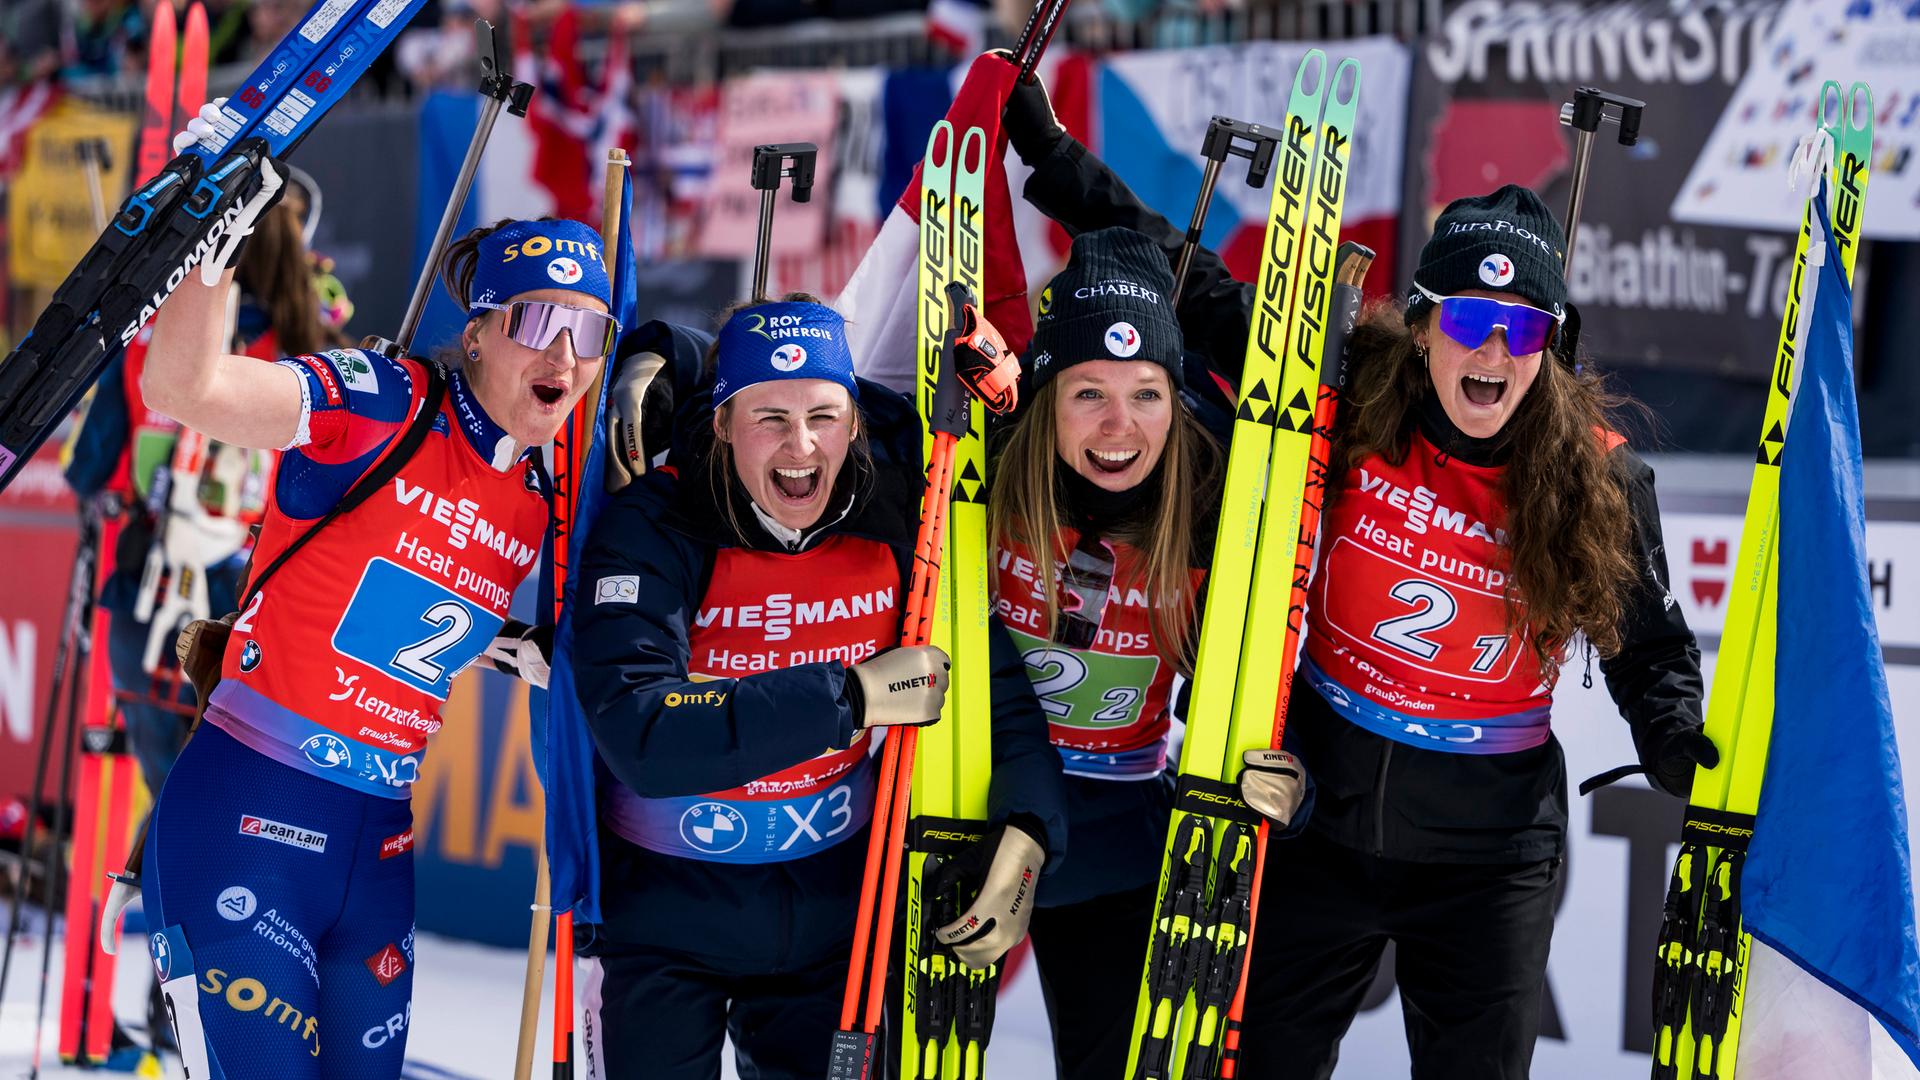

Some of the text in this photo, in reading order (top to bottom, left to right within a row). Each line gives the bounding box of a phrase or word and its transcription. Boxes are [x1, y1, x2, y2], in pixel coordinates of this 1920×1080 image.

[1257, 115, 1313, 362] FISCHER
[1297, 124, 1348, 372] FISCHER
[122, 198, 246, 347] SALOMON
[1074, 284, 1160, 304] CHABERT
[769, 315, 803, 328] ROY
[770, 327, 833, 341] ENERGIE
[394, 476, 536, 568] VIESSMANN
[1354, 514, 1414, 559] Heat
[395, 531, 511, 610] Heat pumps
[234, 590, 264, 632] 2
[694, 586, 894, 642] VIESSMANN
[998, 598, 1042, 629] eat
[1370, 578, 1511, 674] 2 1
[389, 600, 474, 686] 2
[708, 647, 779, 672] Heat
[664, 689, 727, 707] omfy
[1021, 647, 1141, 722] 2 2
[261, 823, 325, 847] Jean Lain
[767, 807, 777, 829] NEW
[778, 785, 852, 851] X3
[922, 829, 984, 843] FISCHE
[1686, 819, 1753, 838] FISCHER
[906, 875, 920, 1016] FISCHER
[362, 999, 413, 1049] CRA
[583, 1007, 596, 1079] CRAFT
